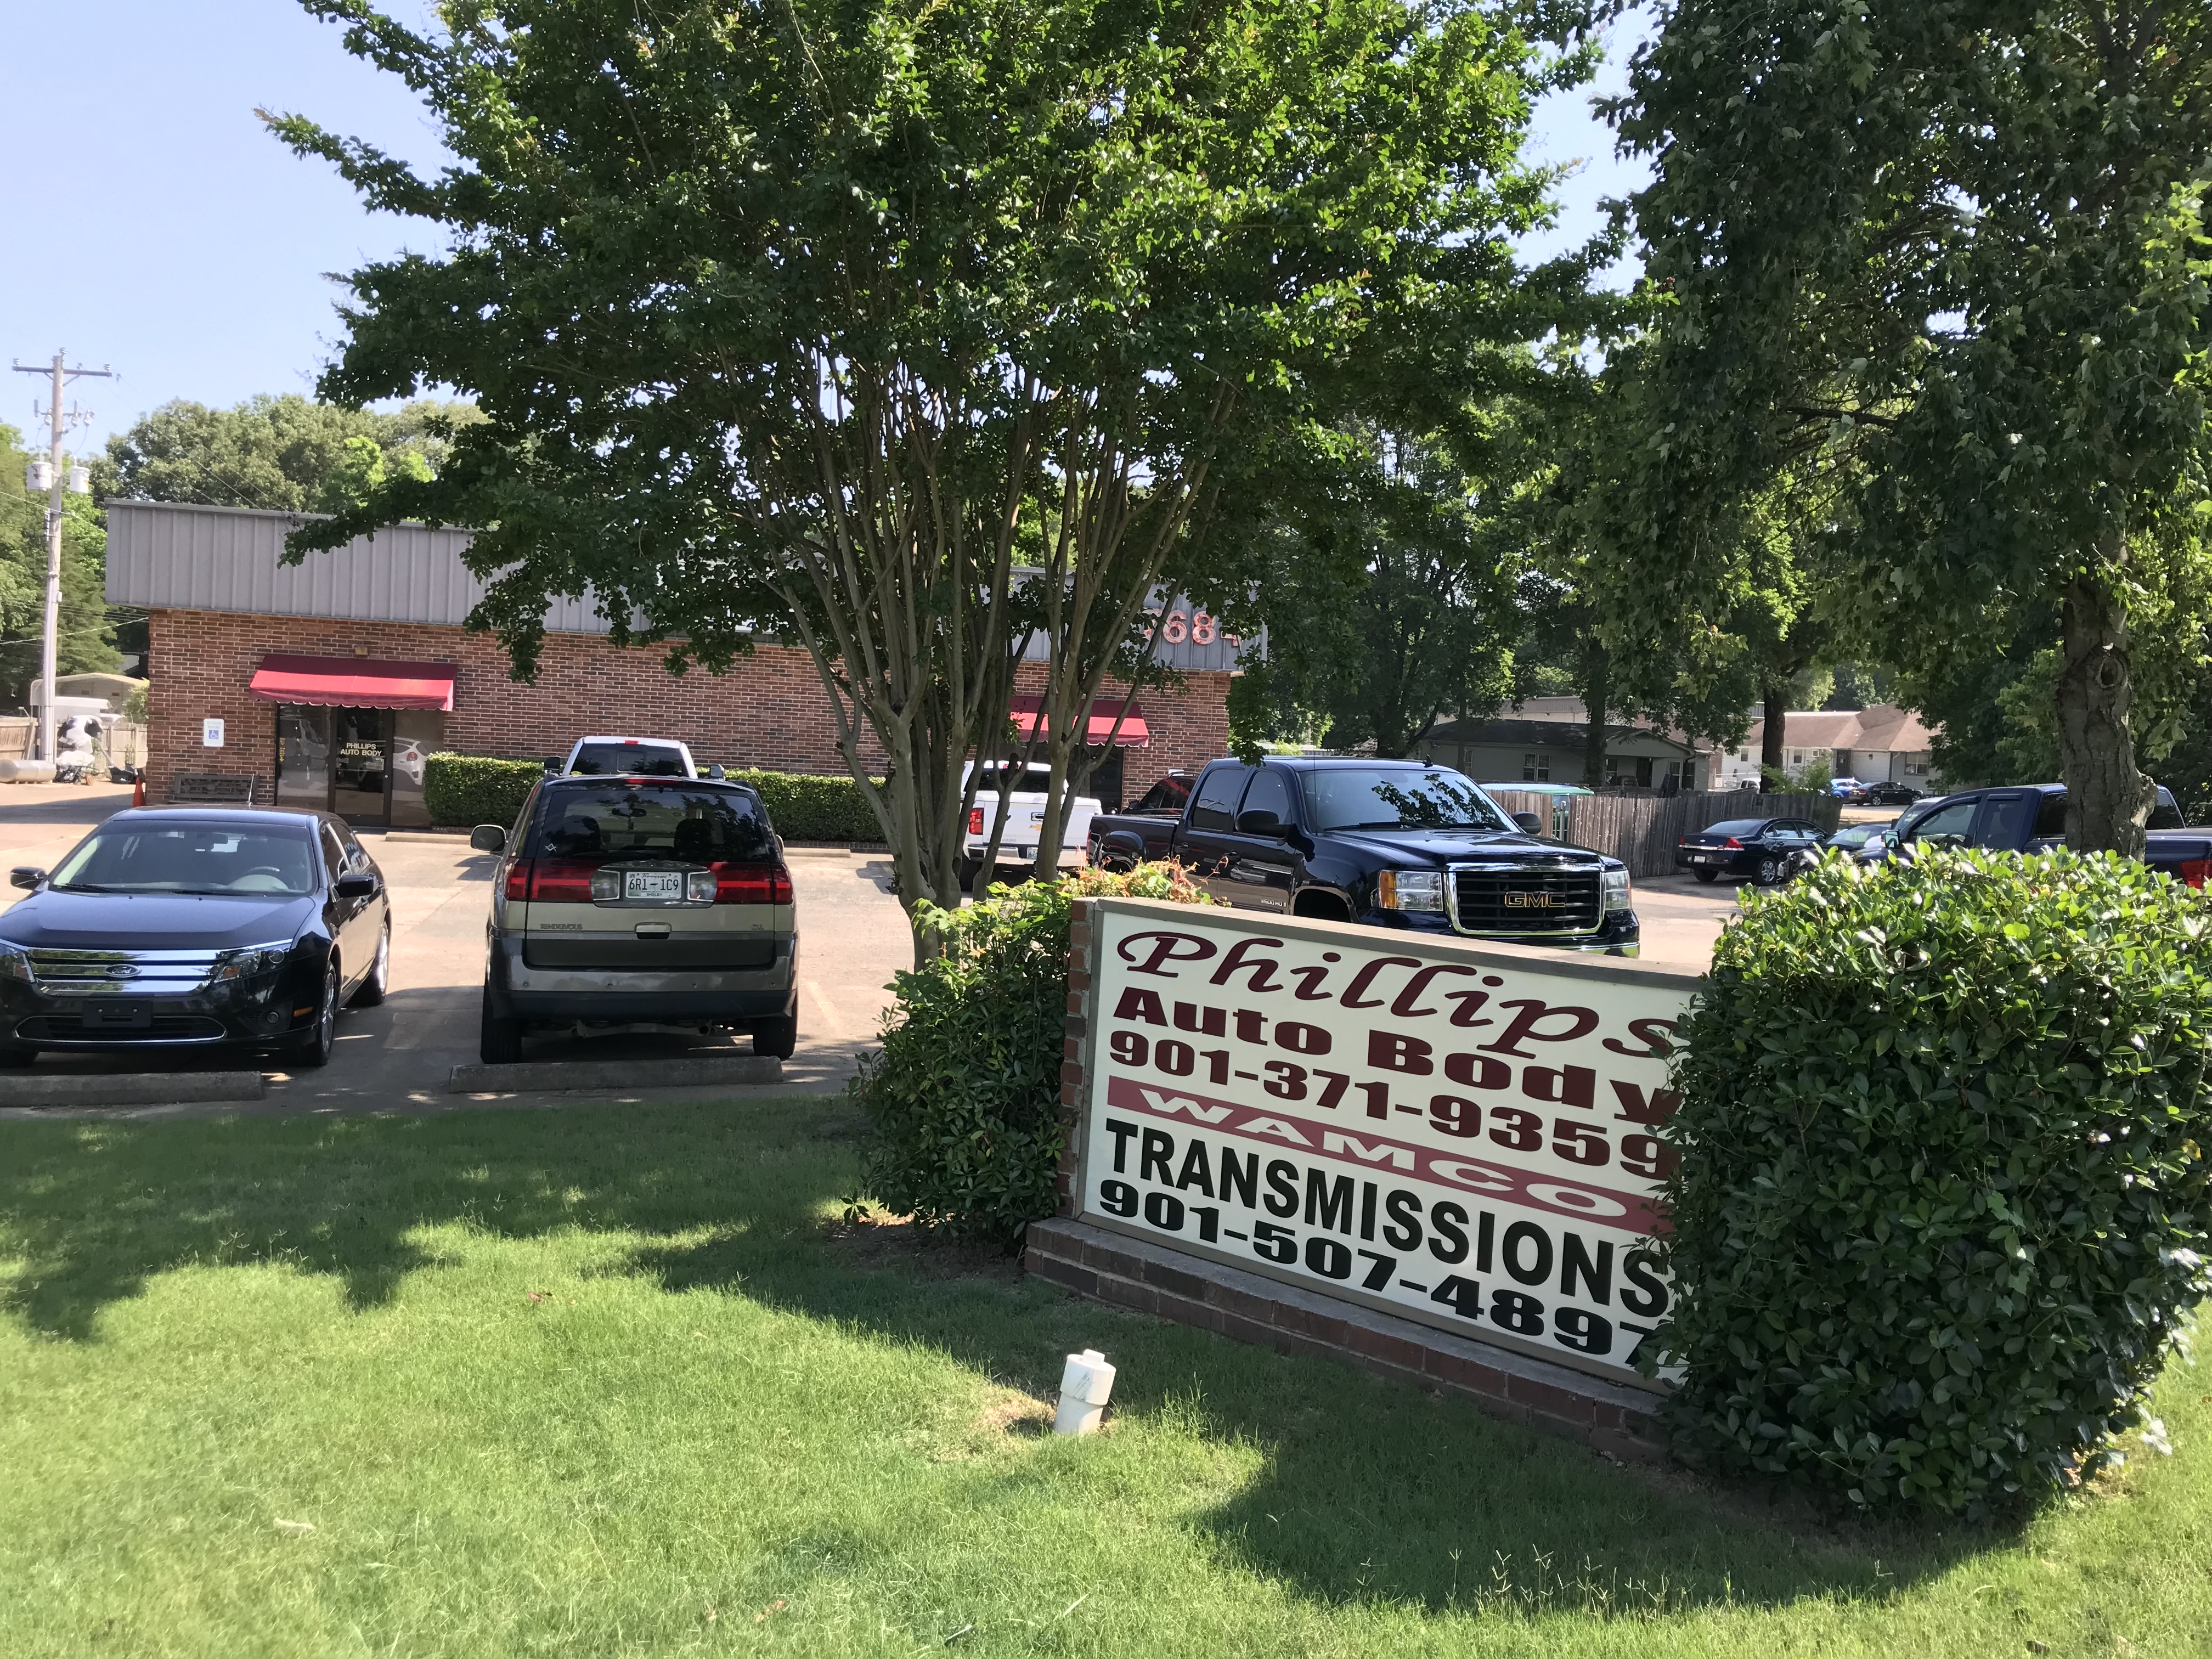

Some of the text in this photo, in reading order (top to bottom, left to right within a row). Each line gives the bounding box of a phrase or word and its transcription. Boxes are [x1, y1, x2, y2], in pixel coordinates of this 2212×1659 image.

[1504, 891, 1566, 908] GMC
[1113, 986, 1685, 1126] Auto Body
[1117, 931, 1688, 1059] Phillips
[1109, 1030, 1683, 1182] 901-371-9359
[1138, 1088, 1627, 1217] WAMCO
[1099, 1179, 1657, 1365] 901-507-4897
[1105, 1118, 1669, 1318] TRANSMISSIONS
